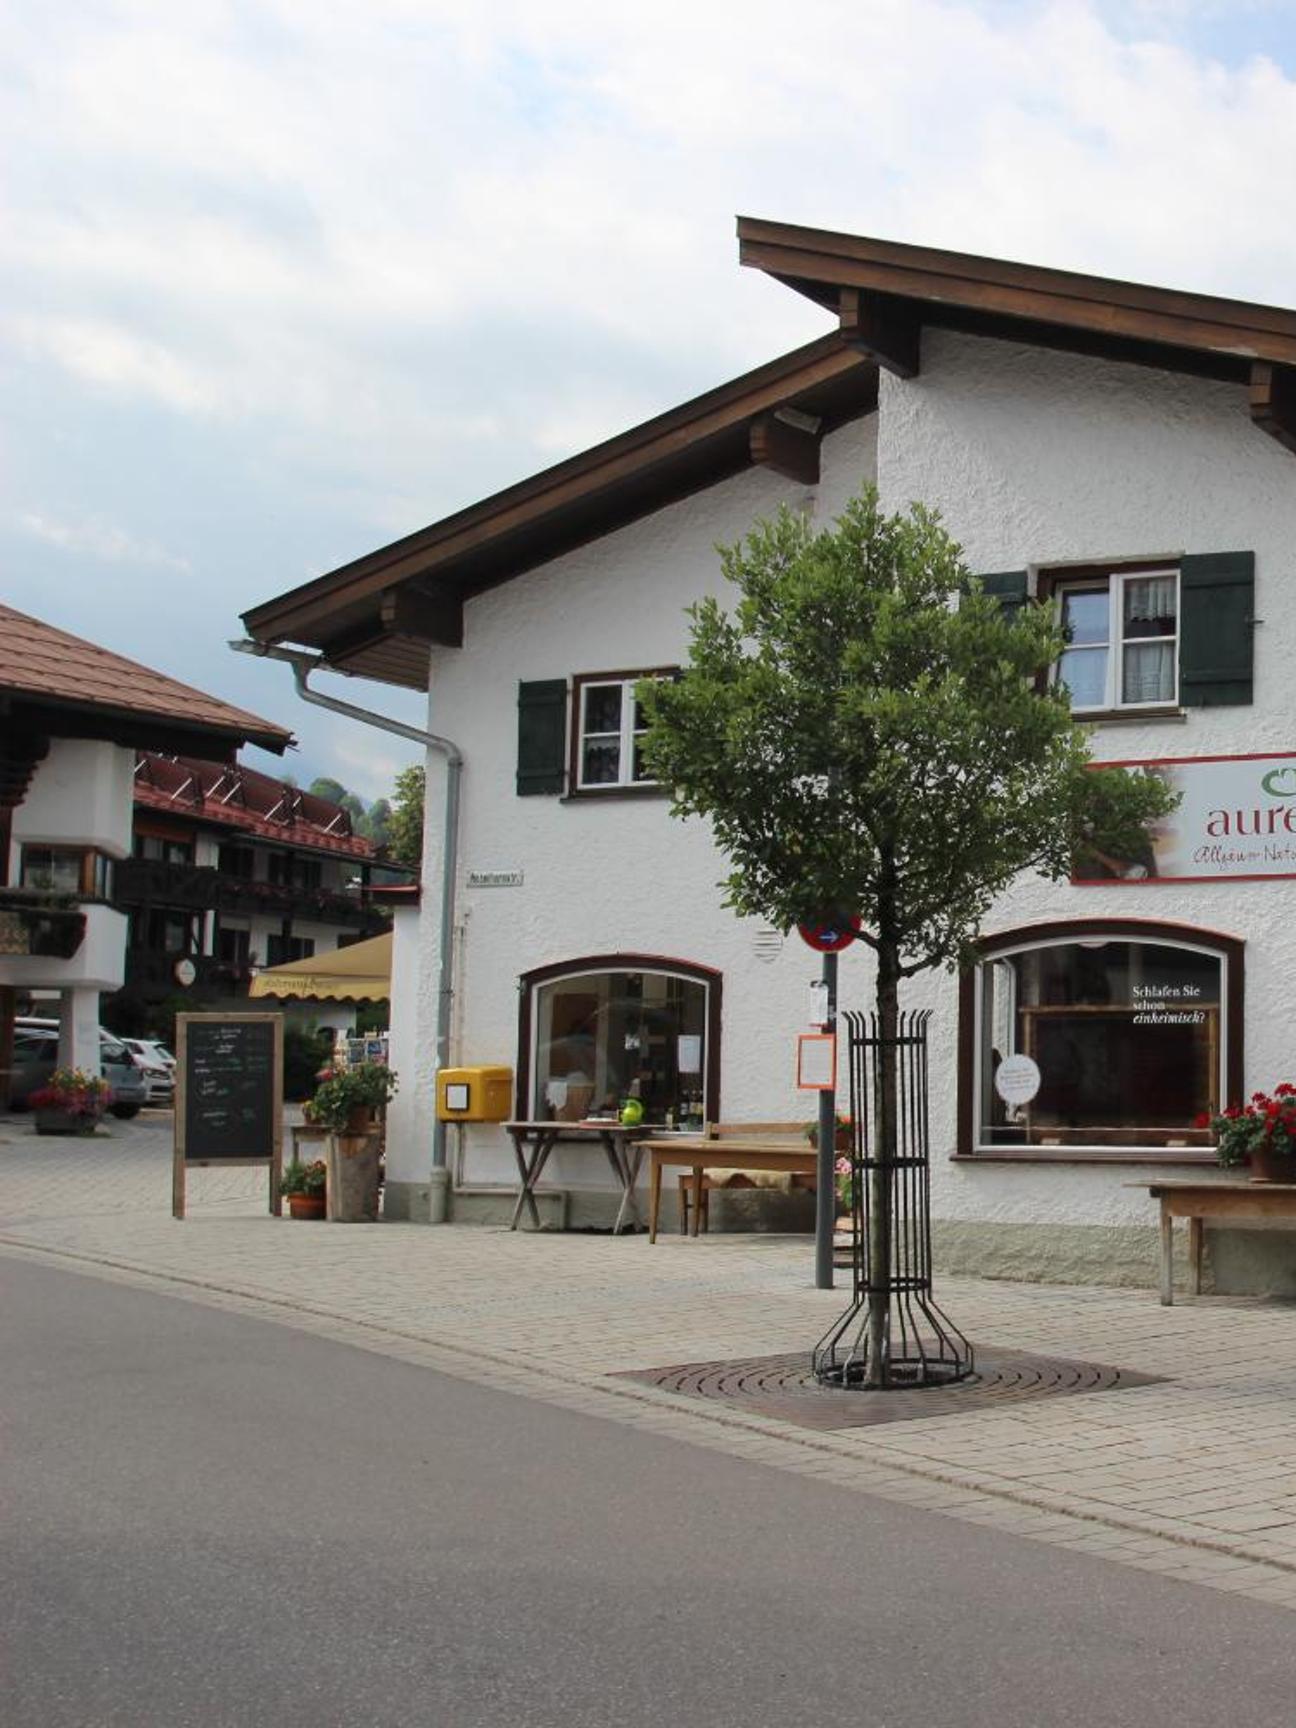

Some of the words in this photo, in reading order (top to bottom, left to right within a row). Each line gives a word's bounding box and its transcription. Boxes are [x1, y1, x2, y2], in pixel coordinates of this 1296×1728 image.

[1132, 985, 1181, 998] Schlafen
[1183, 984, 1201, 996] Sie
[1132, 1010, 1206, 1024] einheimisch?
